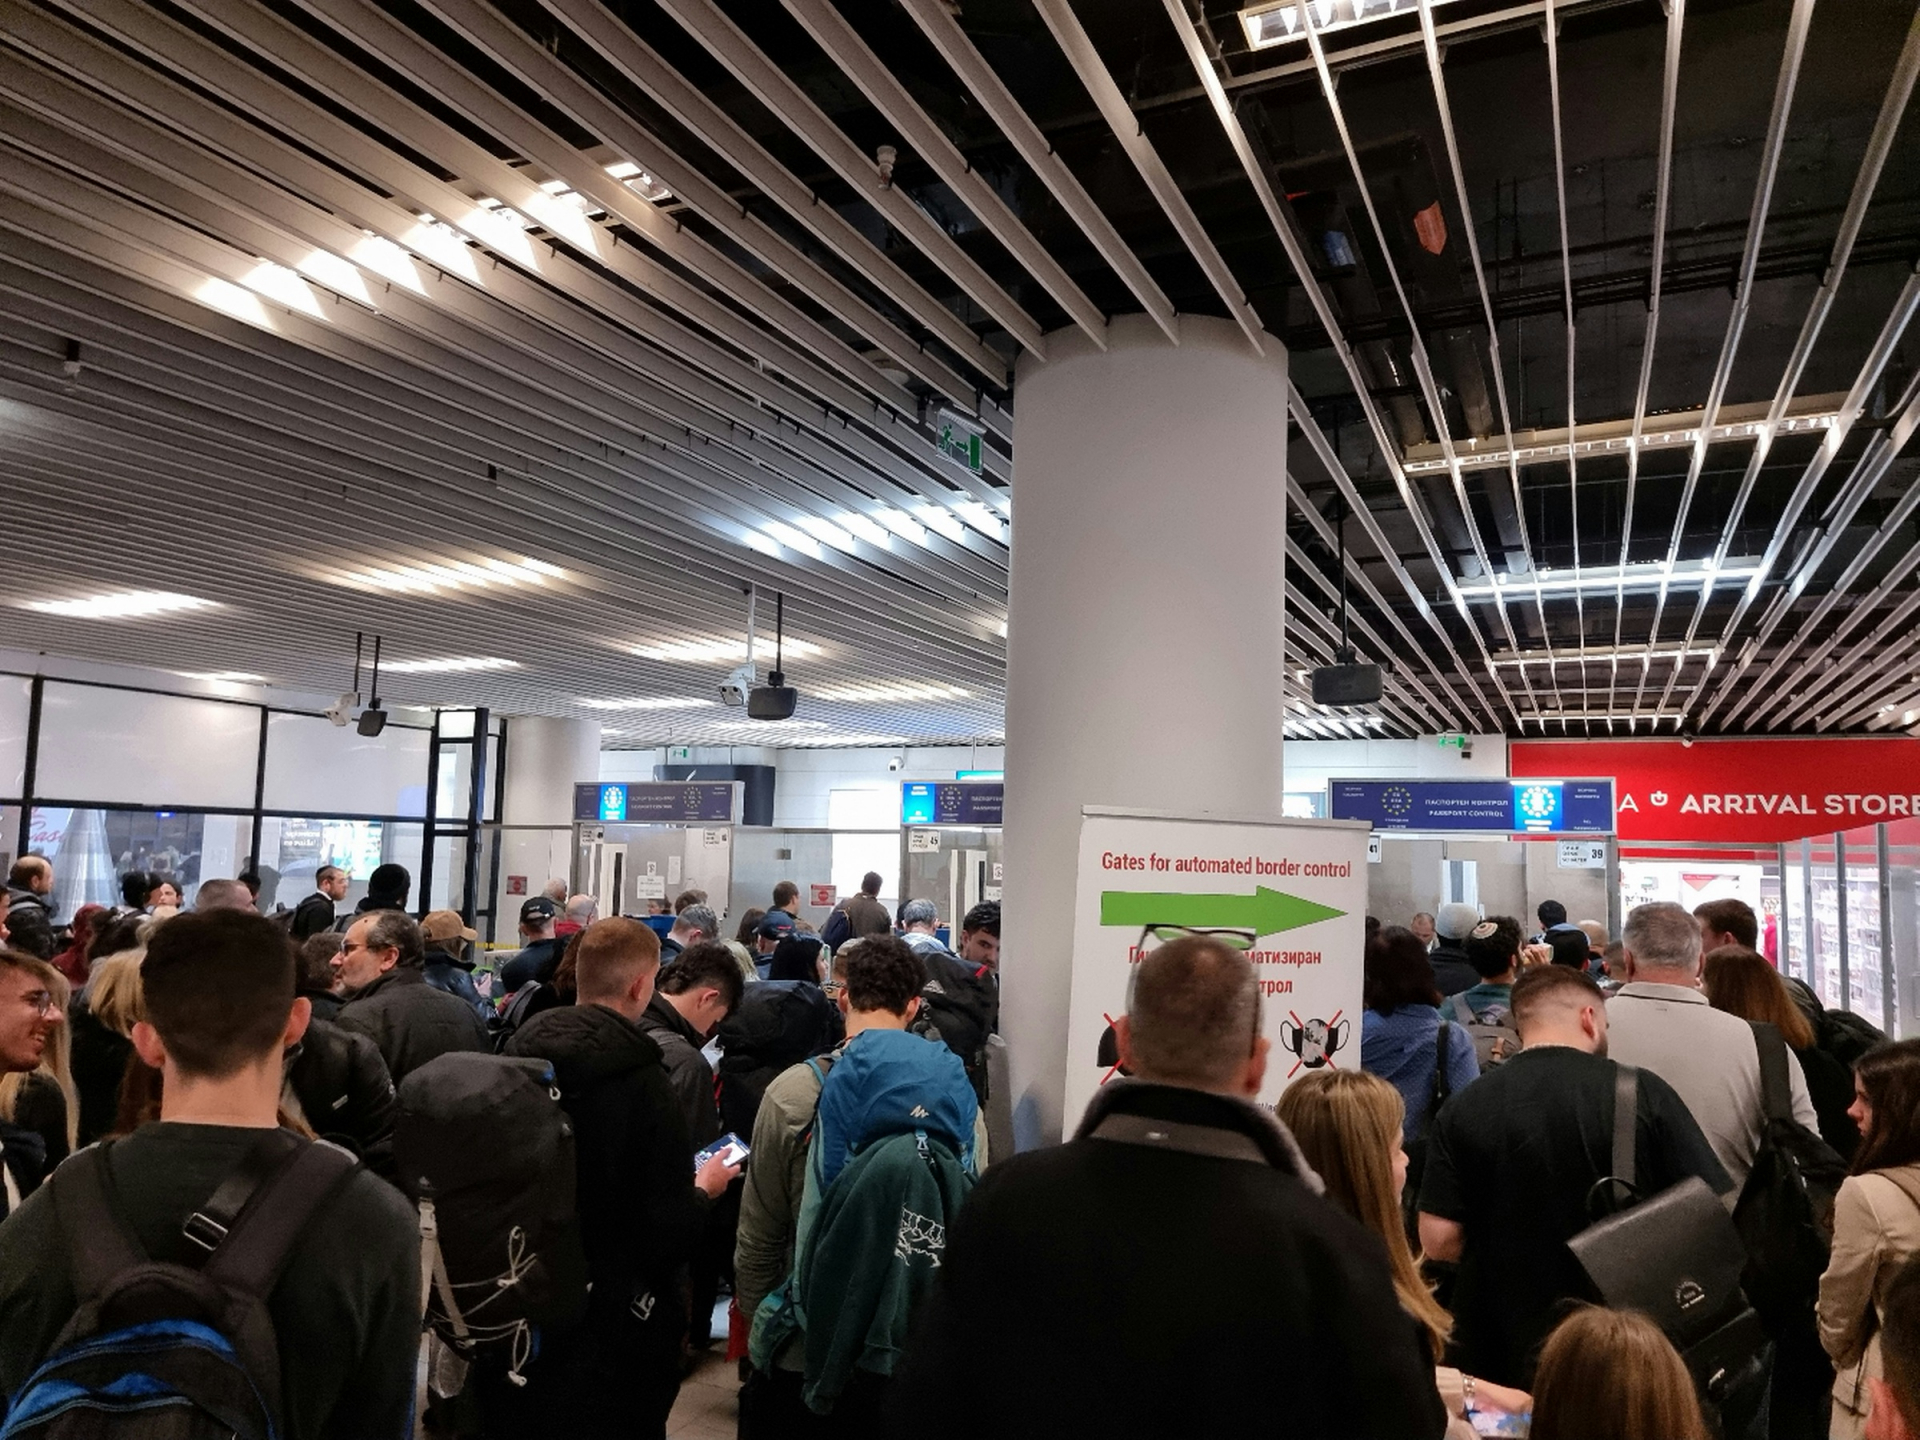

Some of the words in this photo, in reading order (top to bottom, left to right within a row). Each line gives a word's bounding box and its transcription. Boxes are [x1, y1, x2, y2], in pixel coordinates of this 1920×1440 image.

[1471, 799, 1509, 807] КОНТРОЛ
[1680, 794, 1817, 815] ARRIVAL
[1468, 810, 1505, 818] CONTROL
[1591, 848, 1604, 859] 39
[1101, 851, 1146, 871] Gates
[1149, 852, 1171, 872] for
[1174, 857, 1253, 875] automated
[1255, 857, 1301, 877] border
[1303, 860, 1352, 878] control
[1244, 950, 1322, 969] матизиран
[1258, 979, 1293, 998] трол
